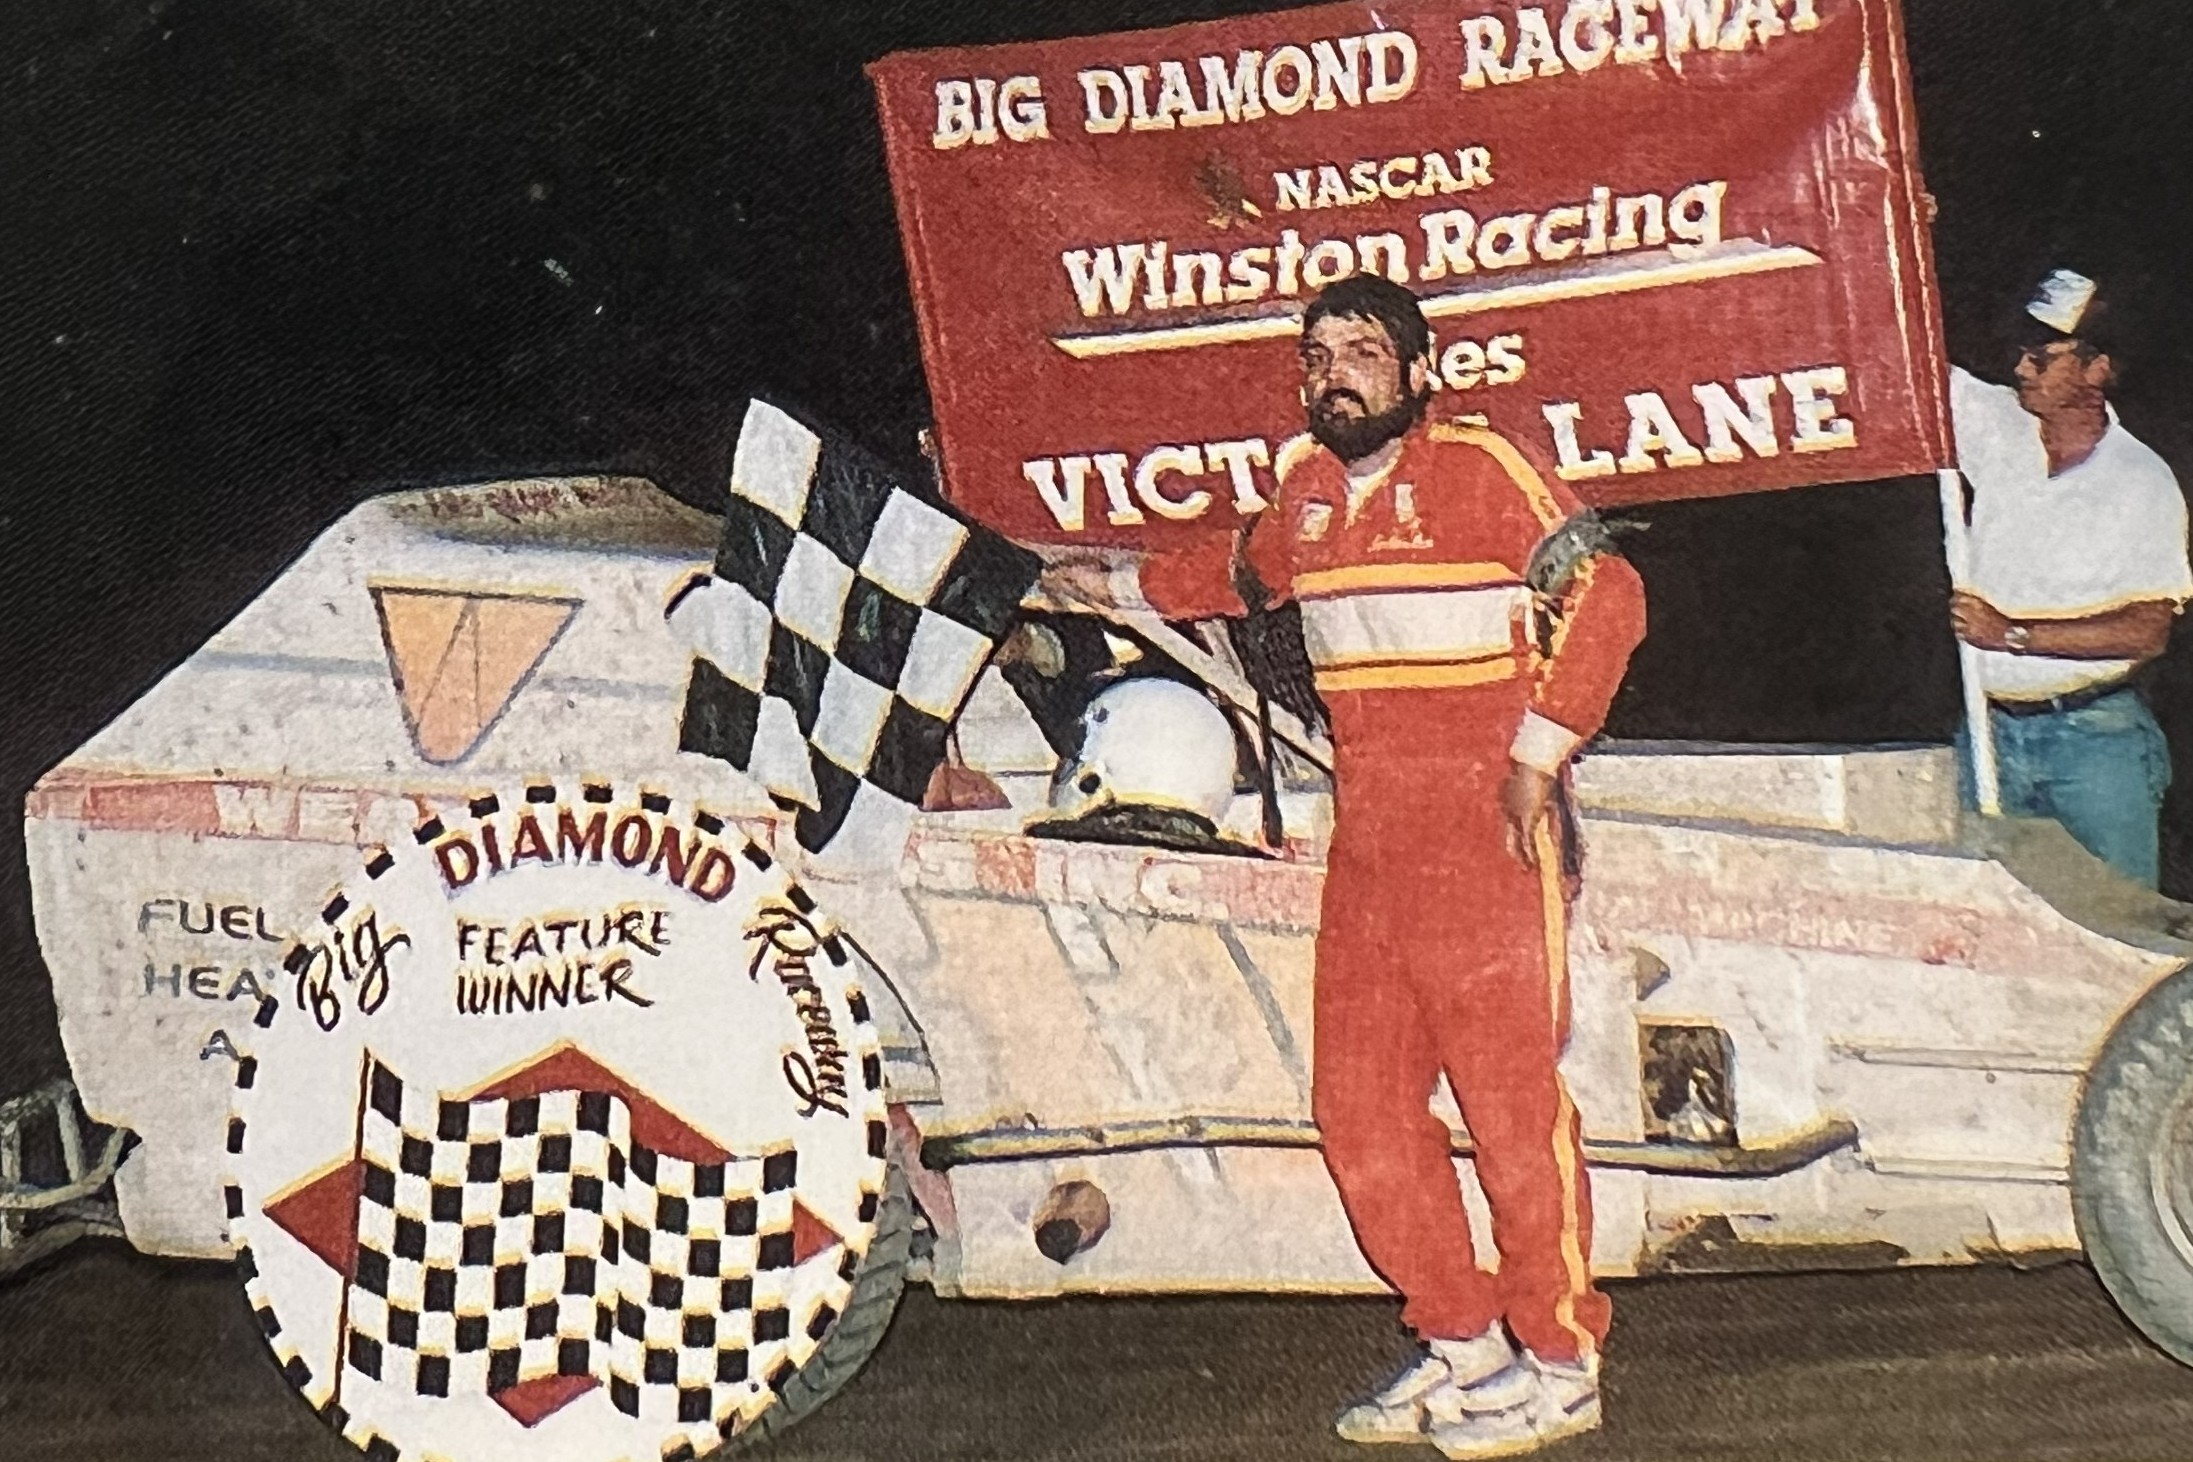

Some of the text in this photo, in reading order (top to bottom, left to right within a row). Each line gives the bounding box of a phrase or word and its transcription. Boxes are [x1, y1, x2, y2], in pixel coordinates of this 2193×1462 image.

[932, 75, 1050, 150] BIG
[1077, 30, 1419, 134] DIAMOND
[1273, 146, 1495, 211] NASCAR
[1061, 180, 1728, 318] Winston Racing
[1543, 365, 1856, 480] LANE
[138, 899, 285, 943] FUEL
[296, 908, 412, 1032] Big
[435, 807, 736, 903] DIAMOND
[457, 906, 672, 967] FEATURE
[142, 962, 270, 1000] HEA
[456, 957, 656, 1016] WINNER
